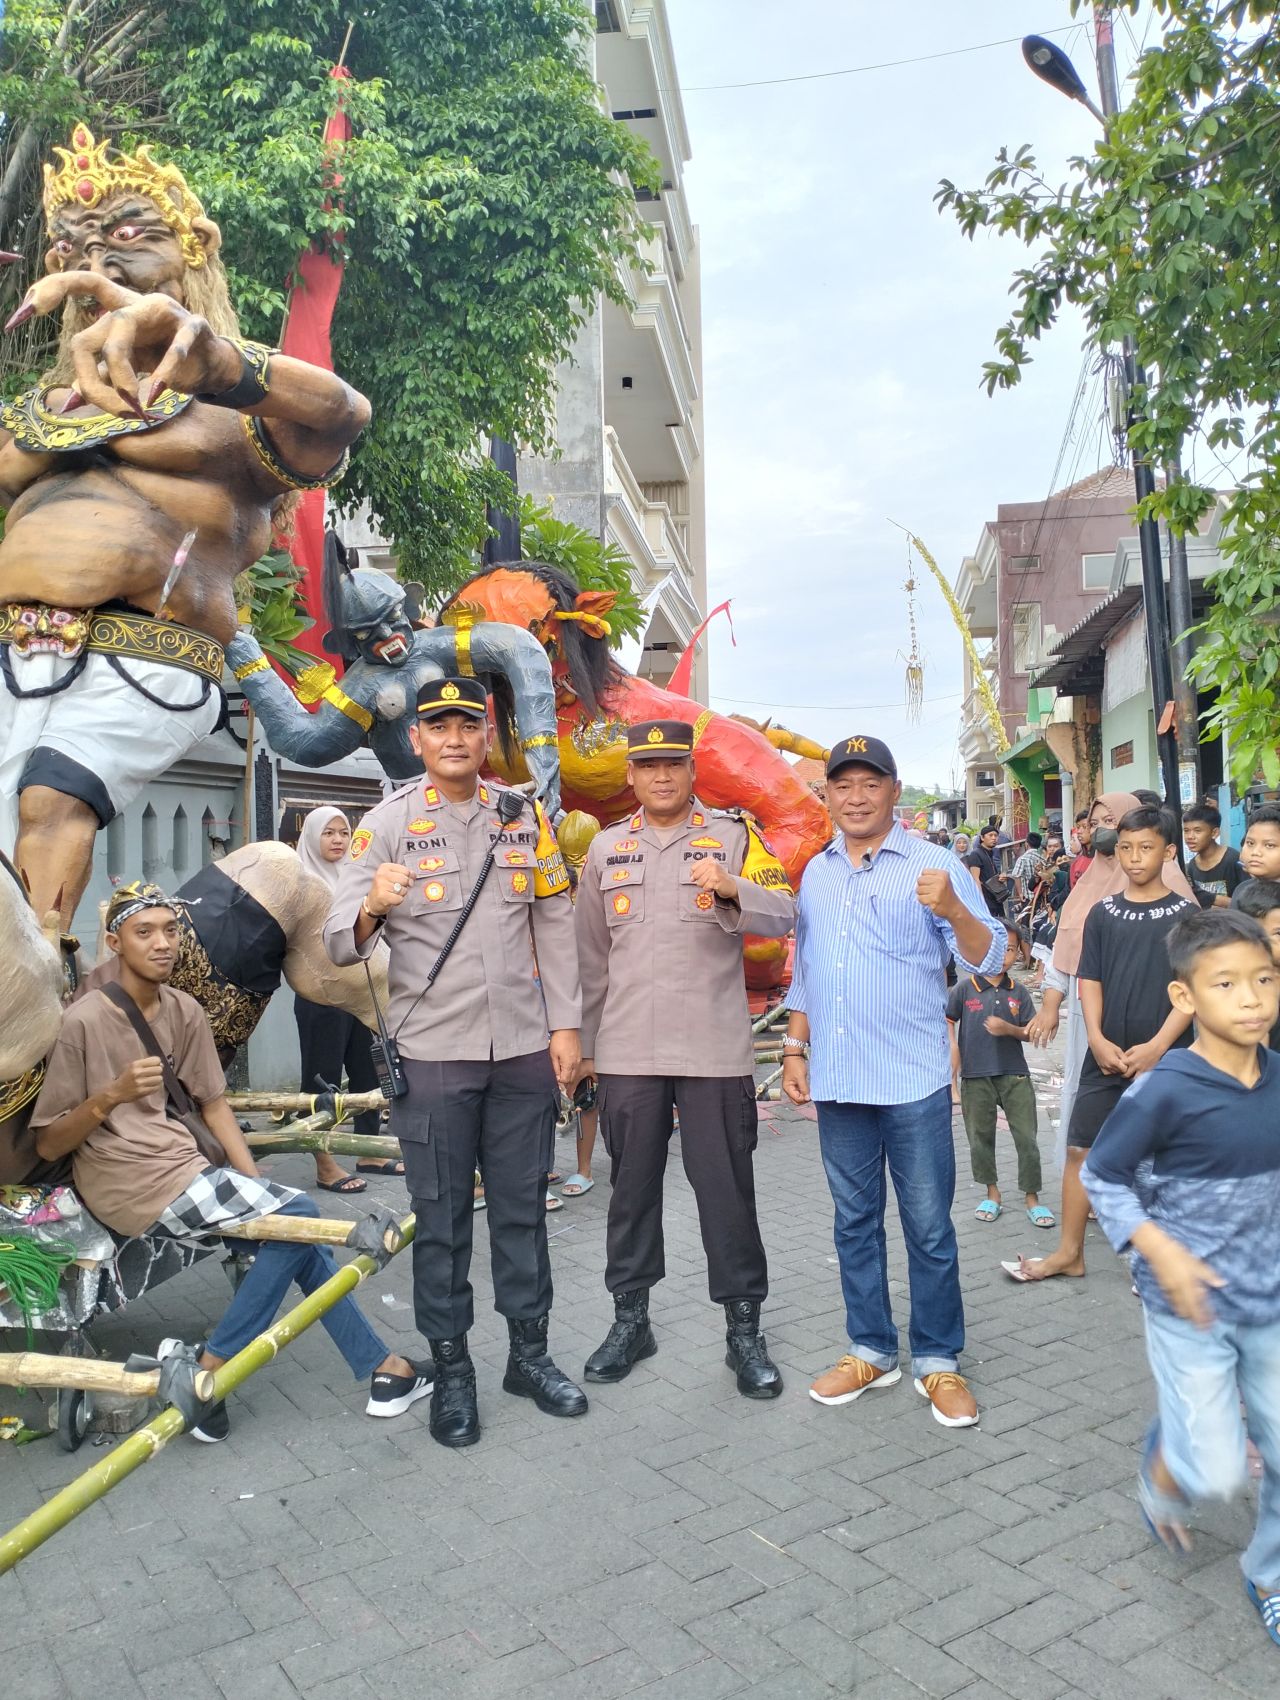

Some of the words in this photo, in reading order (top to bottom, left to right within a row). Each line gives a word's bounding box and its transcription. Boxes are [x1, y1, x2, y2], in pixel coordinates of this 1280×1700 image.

[846, 737, 868, 754] NY
[406, 838, 447, 851] RONI
[489, 833, 530, 844] POLRI
[1123, 909, 1145, 920] for
